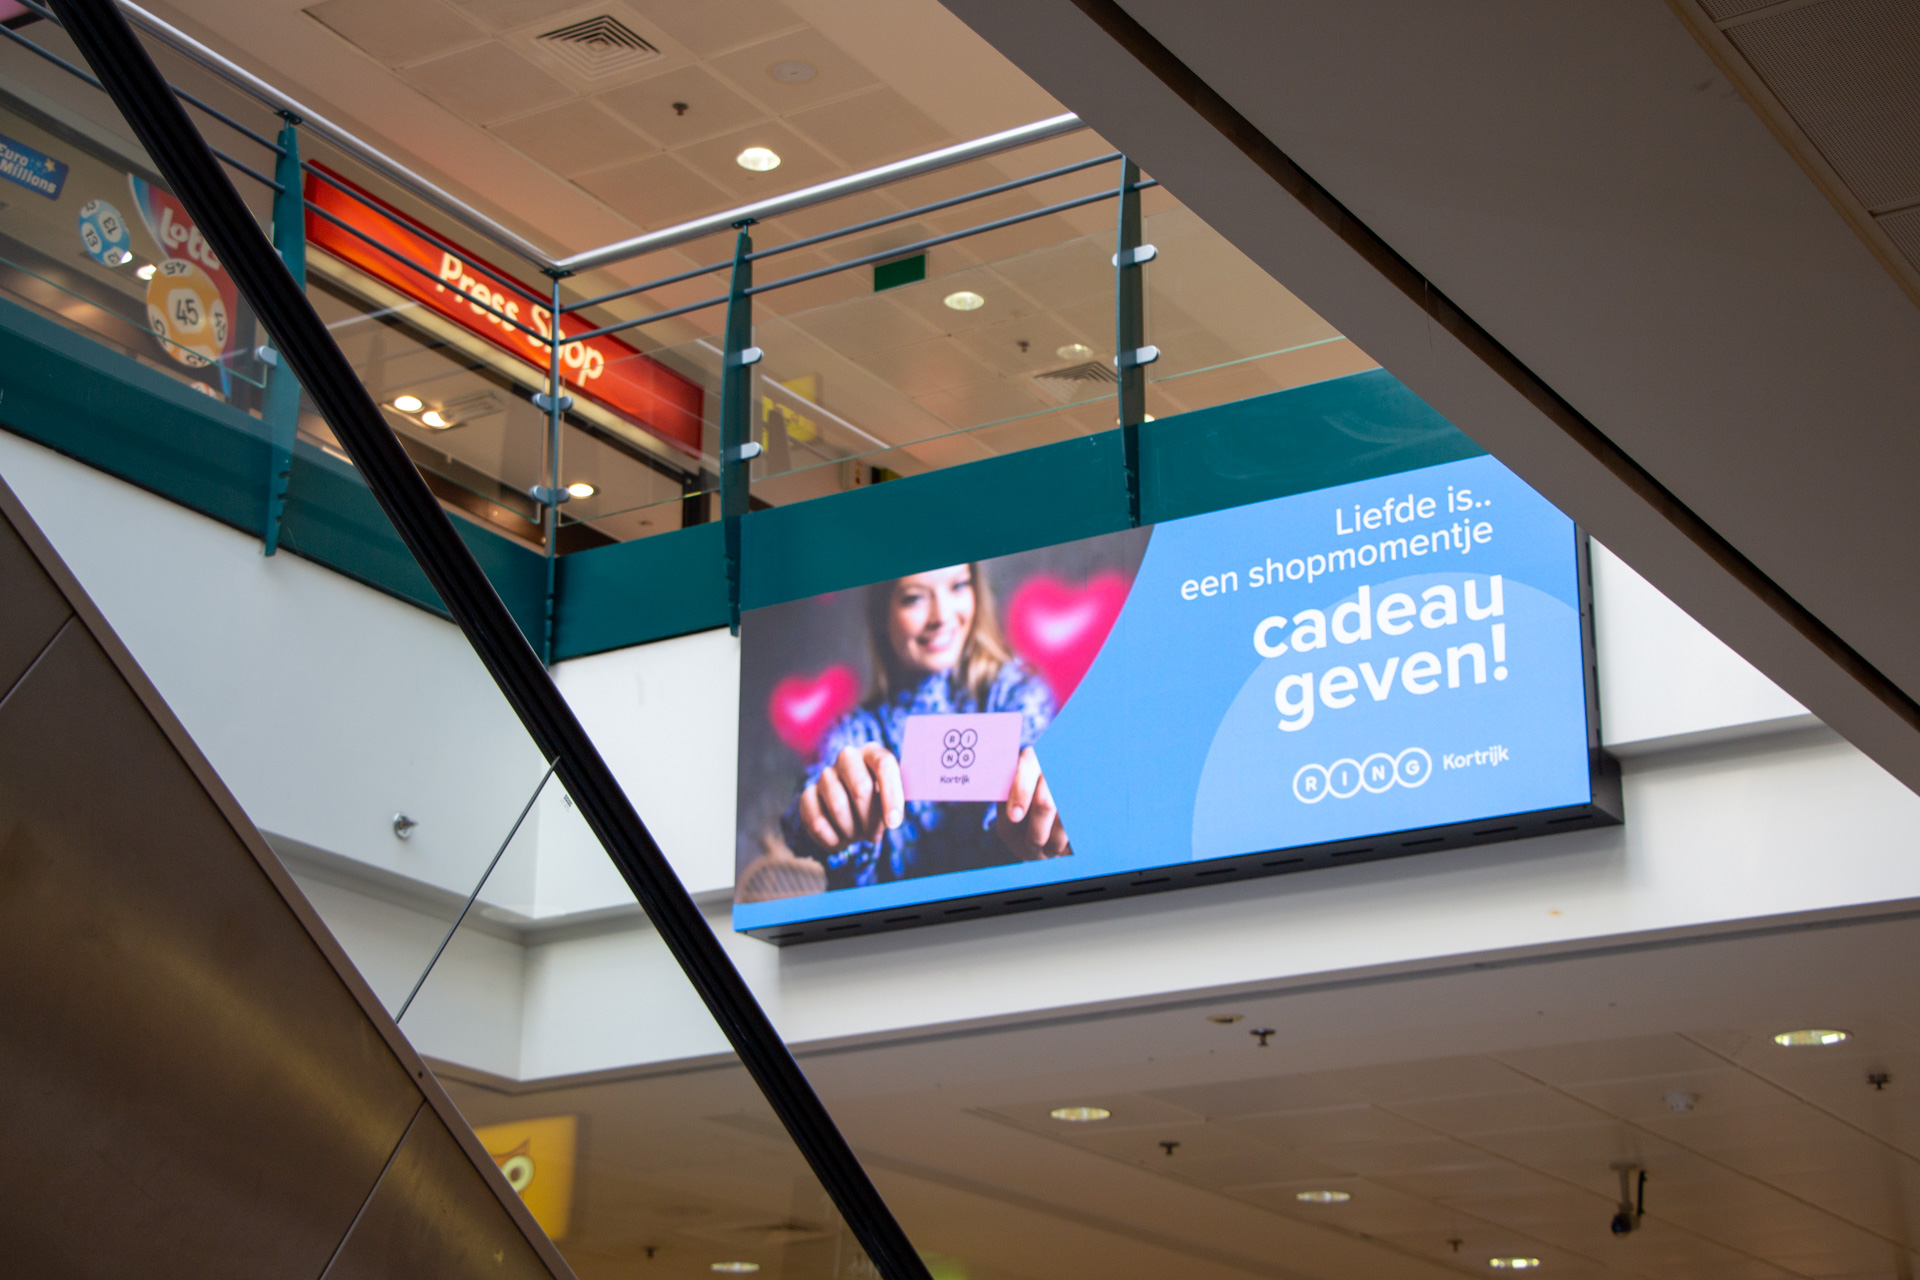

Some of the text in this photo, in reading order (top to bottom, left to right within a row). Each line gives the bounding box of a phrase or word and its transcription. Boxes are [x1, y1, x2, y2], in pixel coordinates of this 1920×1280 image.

[0, 143, 29, 167] Euro
[0, 158, 57, 194] Millions
[85, 229, 99, 248] 13
[103, 216, 117, 236] 13
[165, 262, 187, 275] 45
[436, 252, 519, 332] Press
[175, 299, 199, 325] 45
[1335, 485, 1492, 536] Liefde is..
[1180, 518, 1494, 601] een shopmomentje
[1253, 574, 1505, 659] cadeau
[1274, 622, 1509, 733] geven!
[940, 774, 971, 786] Kortrijk
[1303, 744, 1510, 794] RING Kortrijk
